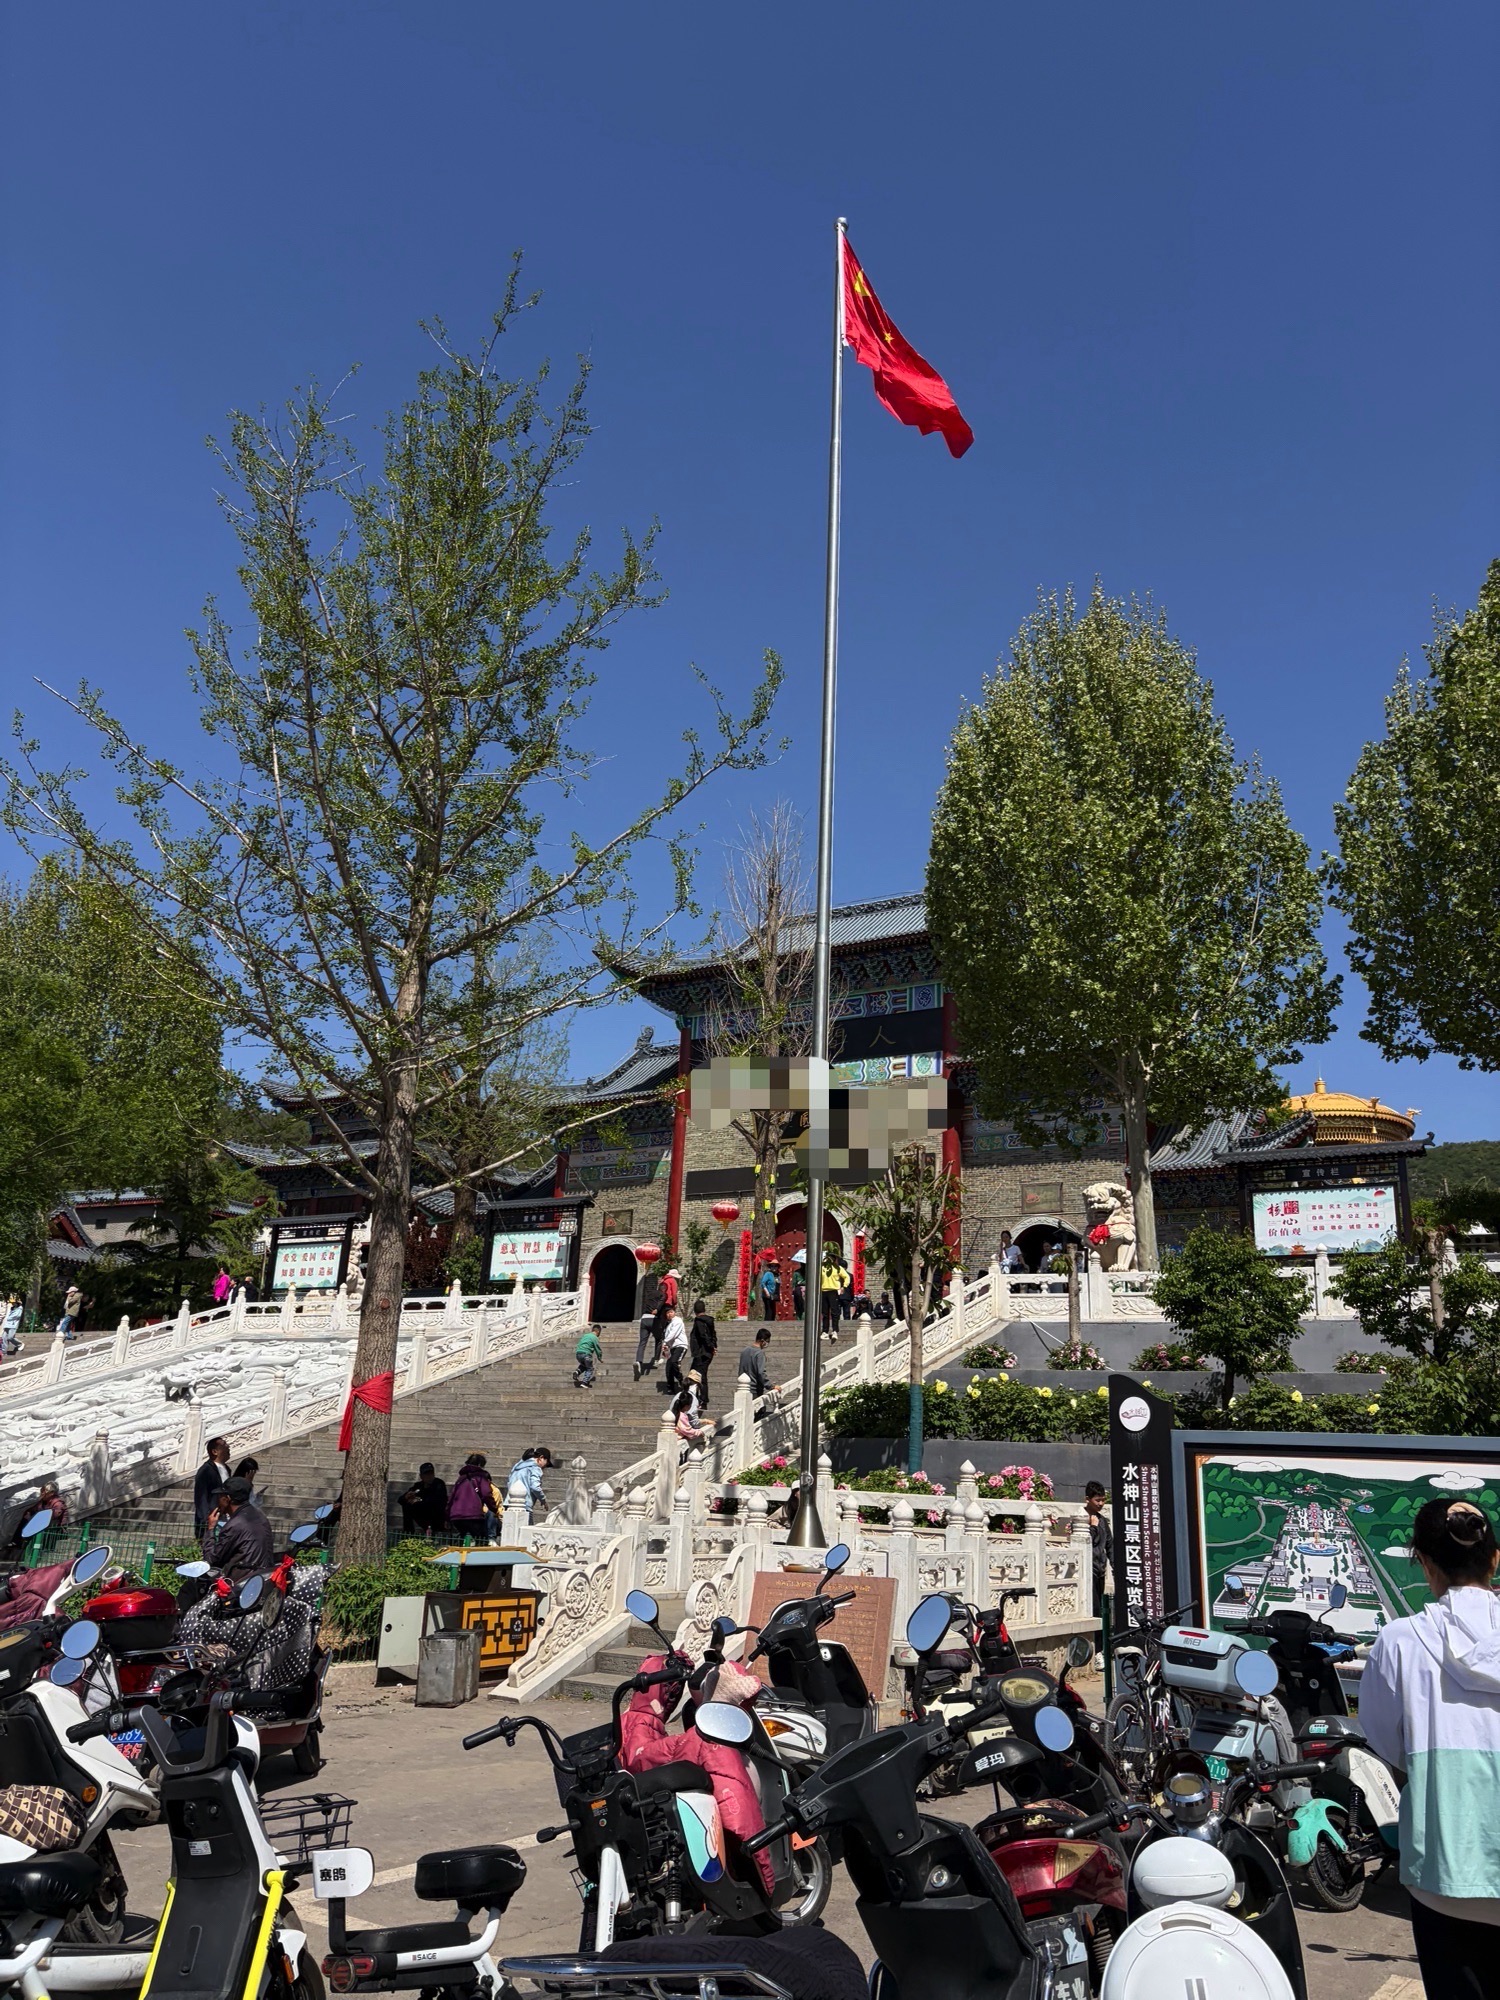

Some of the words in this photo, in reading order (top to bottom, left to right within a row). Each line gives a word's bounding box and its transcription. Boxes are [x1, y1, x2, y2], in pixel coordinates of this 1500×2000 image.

[1302, 1167, 1340, 1178] 宣传栏
[1141, 1466, 1149, 1485] Shui
[1142, 1486, 1150, 1507] Shen
[1143, 1530, 1152, 1558] Scenic
[1144, 1561, 1152, 1580] Spot
[1145, 1582, 1154, 1607] Guide
[1183, 1637, 1202, 1647] 新日
[974, 1751, 1006, 1773] 爱玛
[320, 1867, 347, 1882] 赛鸽
